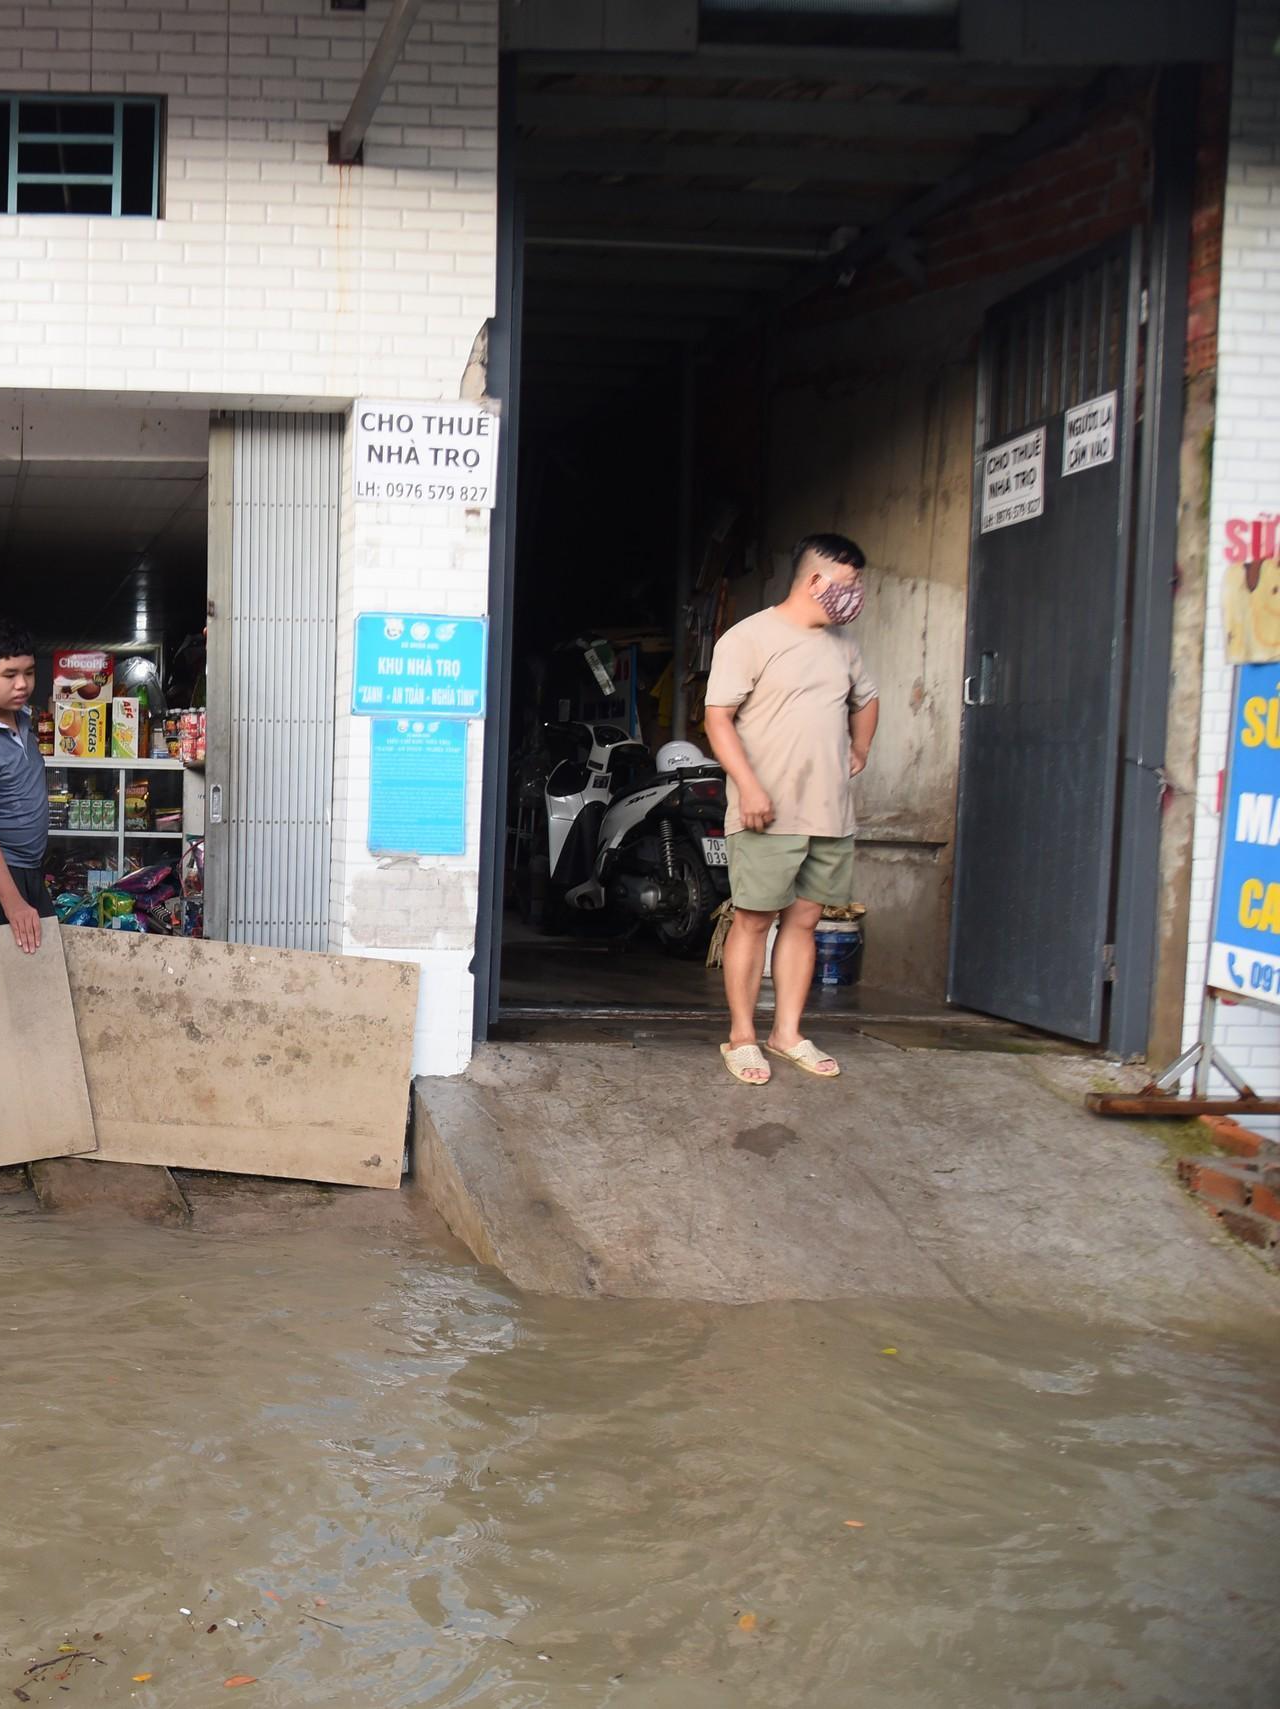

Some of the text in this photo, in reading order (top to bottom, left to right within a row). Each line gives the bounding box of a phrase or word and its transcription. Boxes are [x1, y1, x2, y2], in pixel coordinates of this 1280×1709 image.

[360, 412, 414, 433] CHO
[367, 439, 480, 473] NHÀ TRỌ
[357, 481, 488, 502] LH: 0976 579 827
[377, 654, 461, 681] KHU NHÀ TRỌ
[123, 700, 134, 719] AFC
[88, 708, 100, 753] Custas
